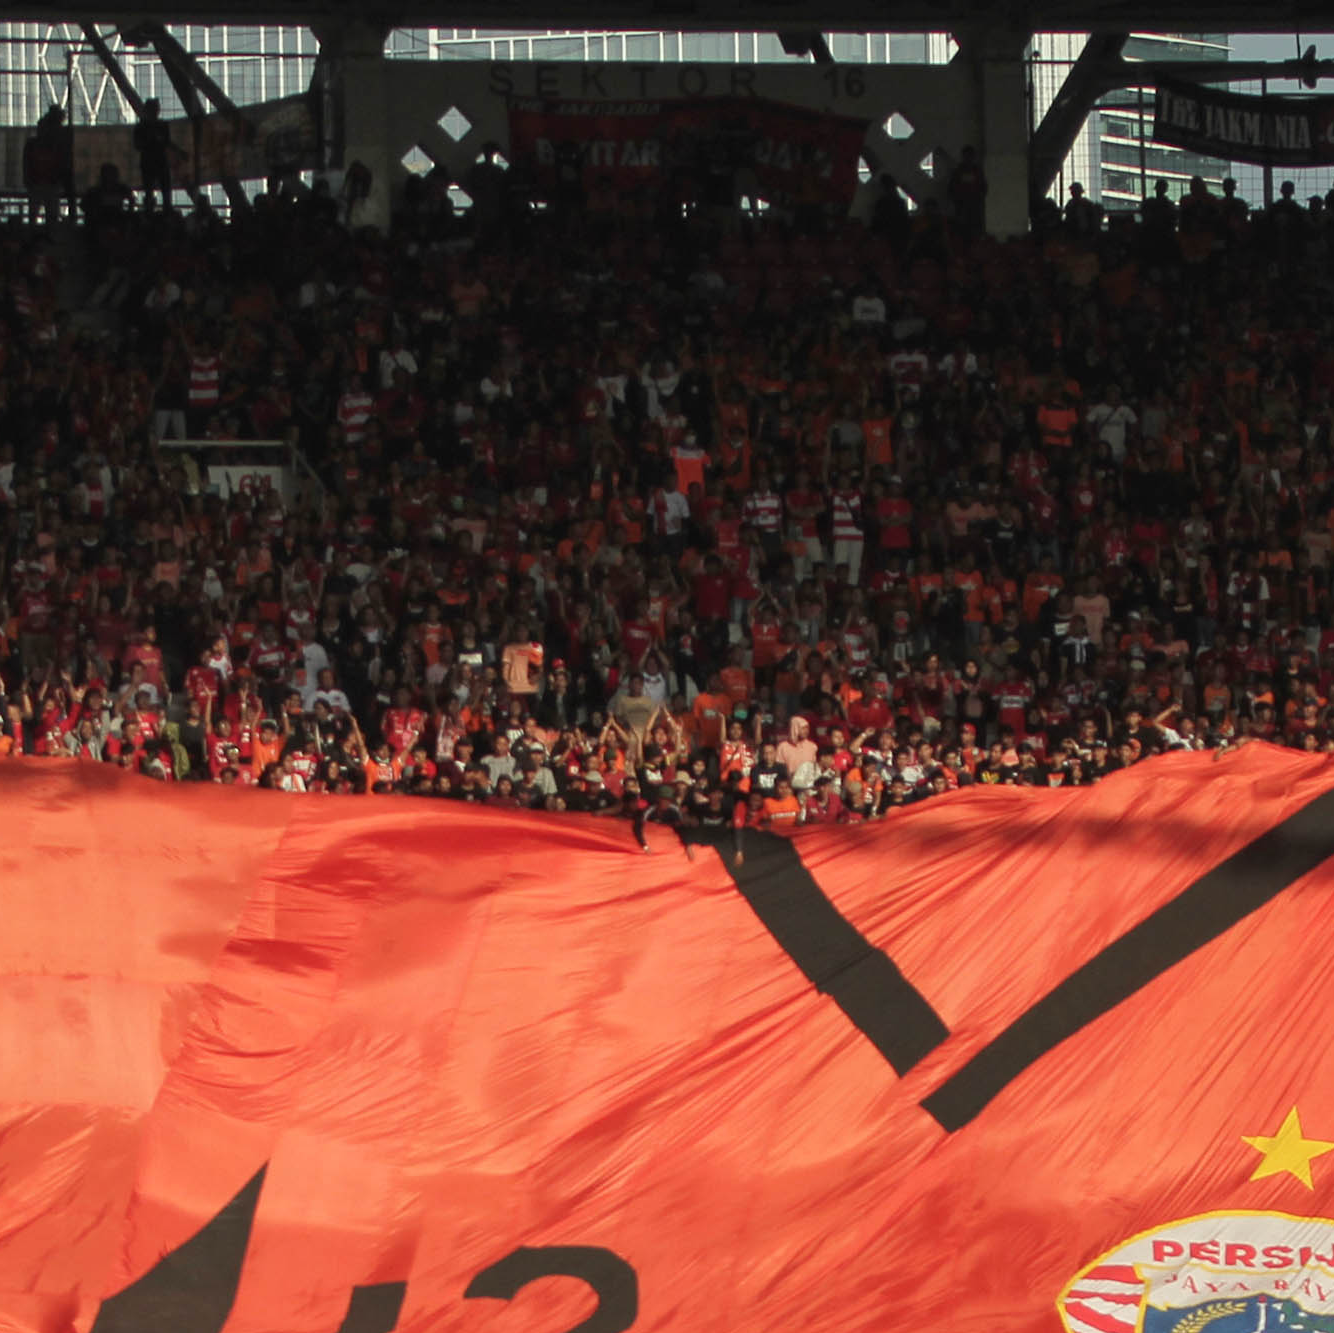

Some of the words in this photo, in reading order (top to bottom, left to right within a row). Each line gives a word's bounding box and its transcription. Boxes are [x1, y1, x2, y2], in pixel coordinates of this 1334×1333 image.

[488, 65, 757, 96] SEKTOR
[823, 68, 865, 98] 16
[1203, 103, 1312, 150] JAKMNIA
